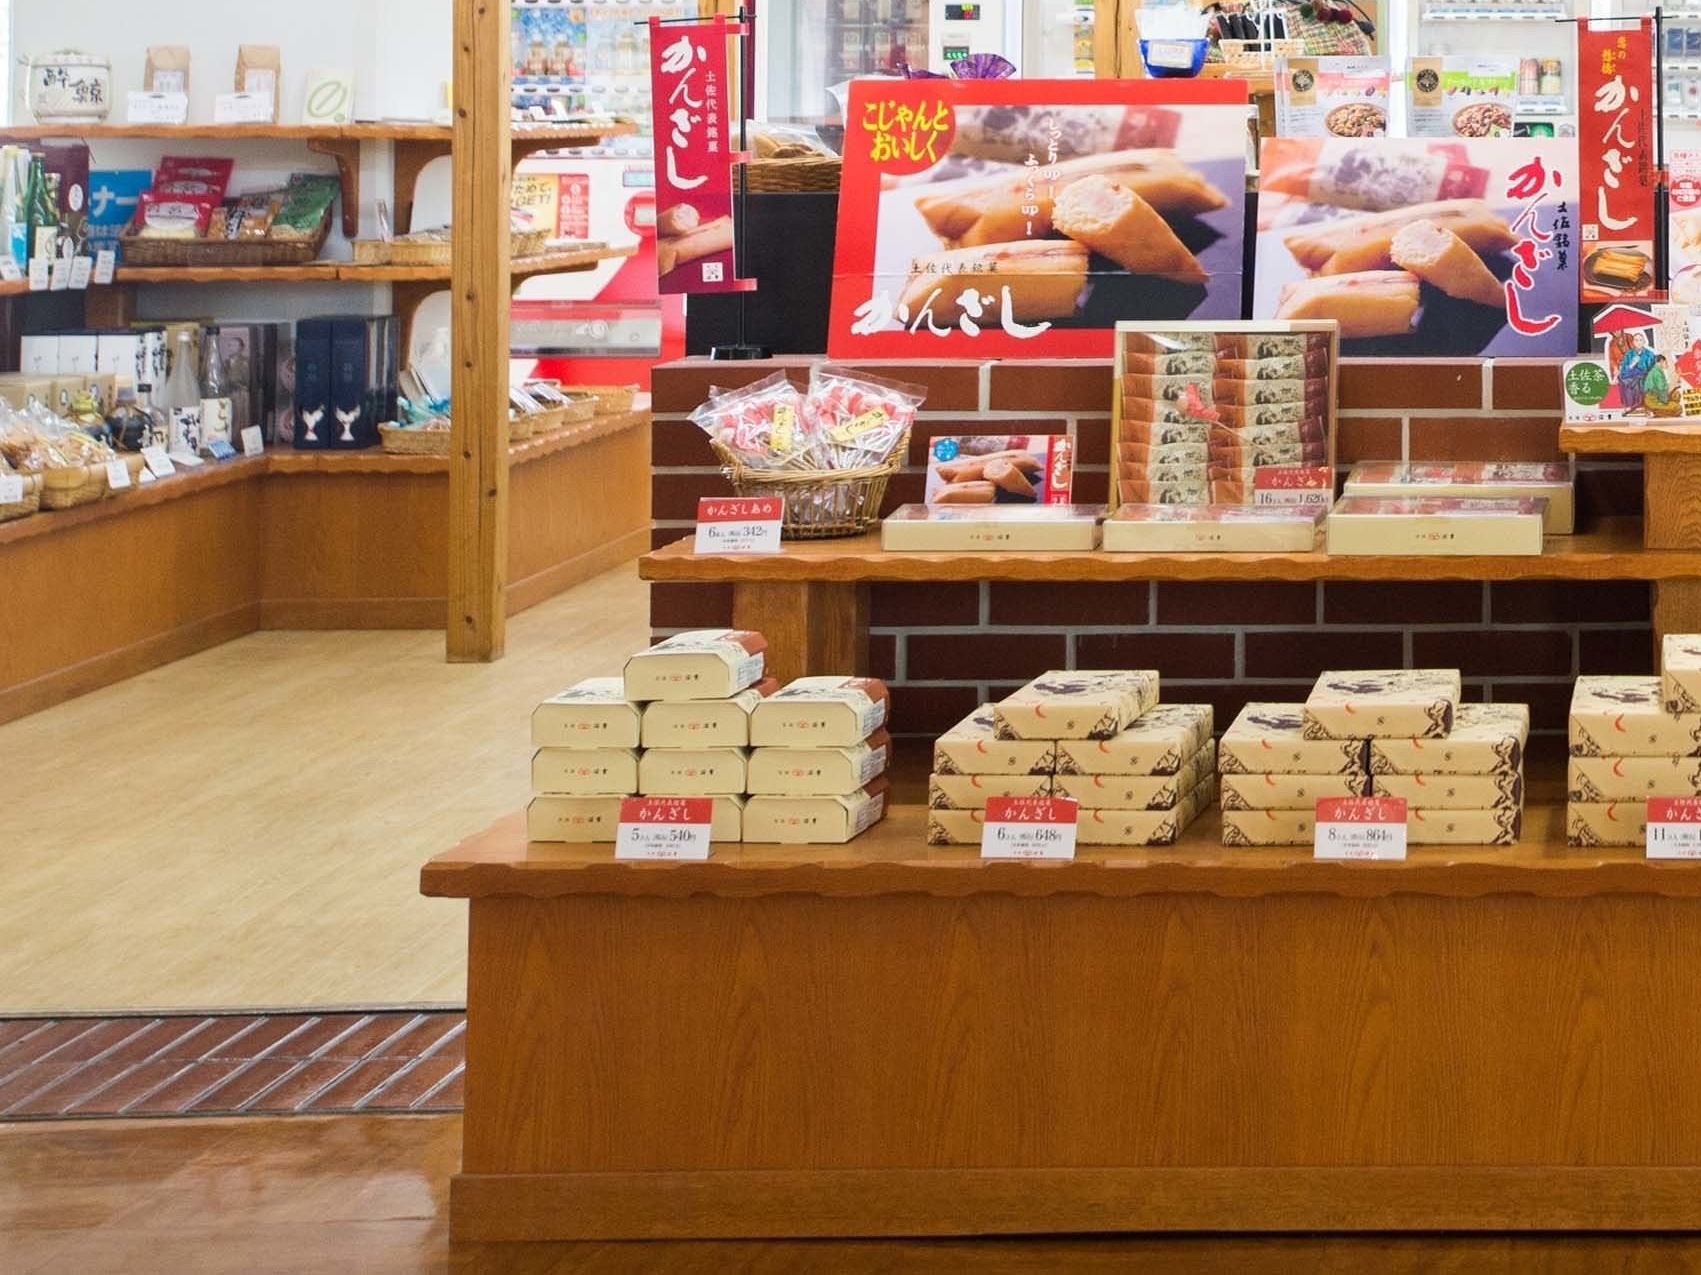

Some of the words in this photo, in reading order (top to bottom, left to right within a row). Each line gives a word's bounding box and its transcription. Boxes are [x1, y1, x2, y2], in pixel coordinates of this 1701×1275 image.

[661, 36, 709, 190] かんざし
[705, 71, 719, 153] 土佐代表銘菓
[863, 100, 949, 132] こじゃんと
[870, 130, 937, 163] おいしく
[1594, 75, 1640, 231] かんざし
[1506, 156, 1561, 336] かんざし
[1553, 201, 1571, 270] 土佐銘菓
[912, 260, 999, 274] 土佐代表銘菓
[851, 285, 1052, 338] かんざし
[1568, 369, 1606, 382] 土佐茶
[1568, 382, 1592, 395] 香る
[706, 503, 772, 516] かんざしあめ
[640, 807, 691, 821] かんざし
[1004, 807, 1056, 820] かんざし
[1334, 807, 1386, 821] かんざし
